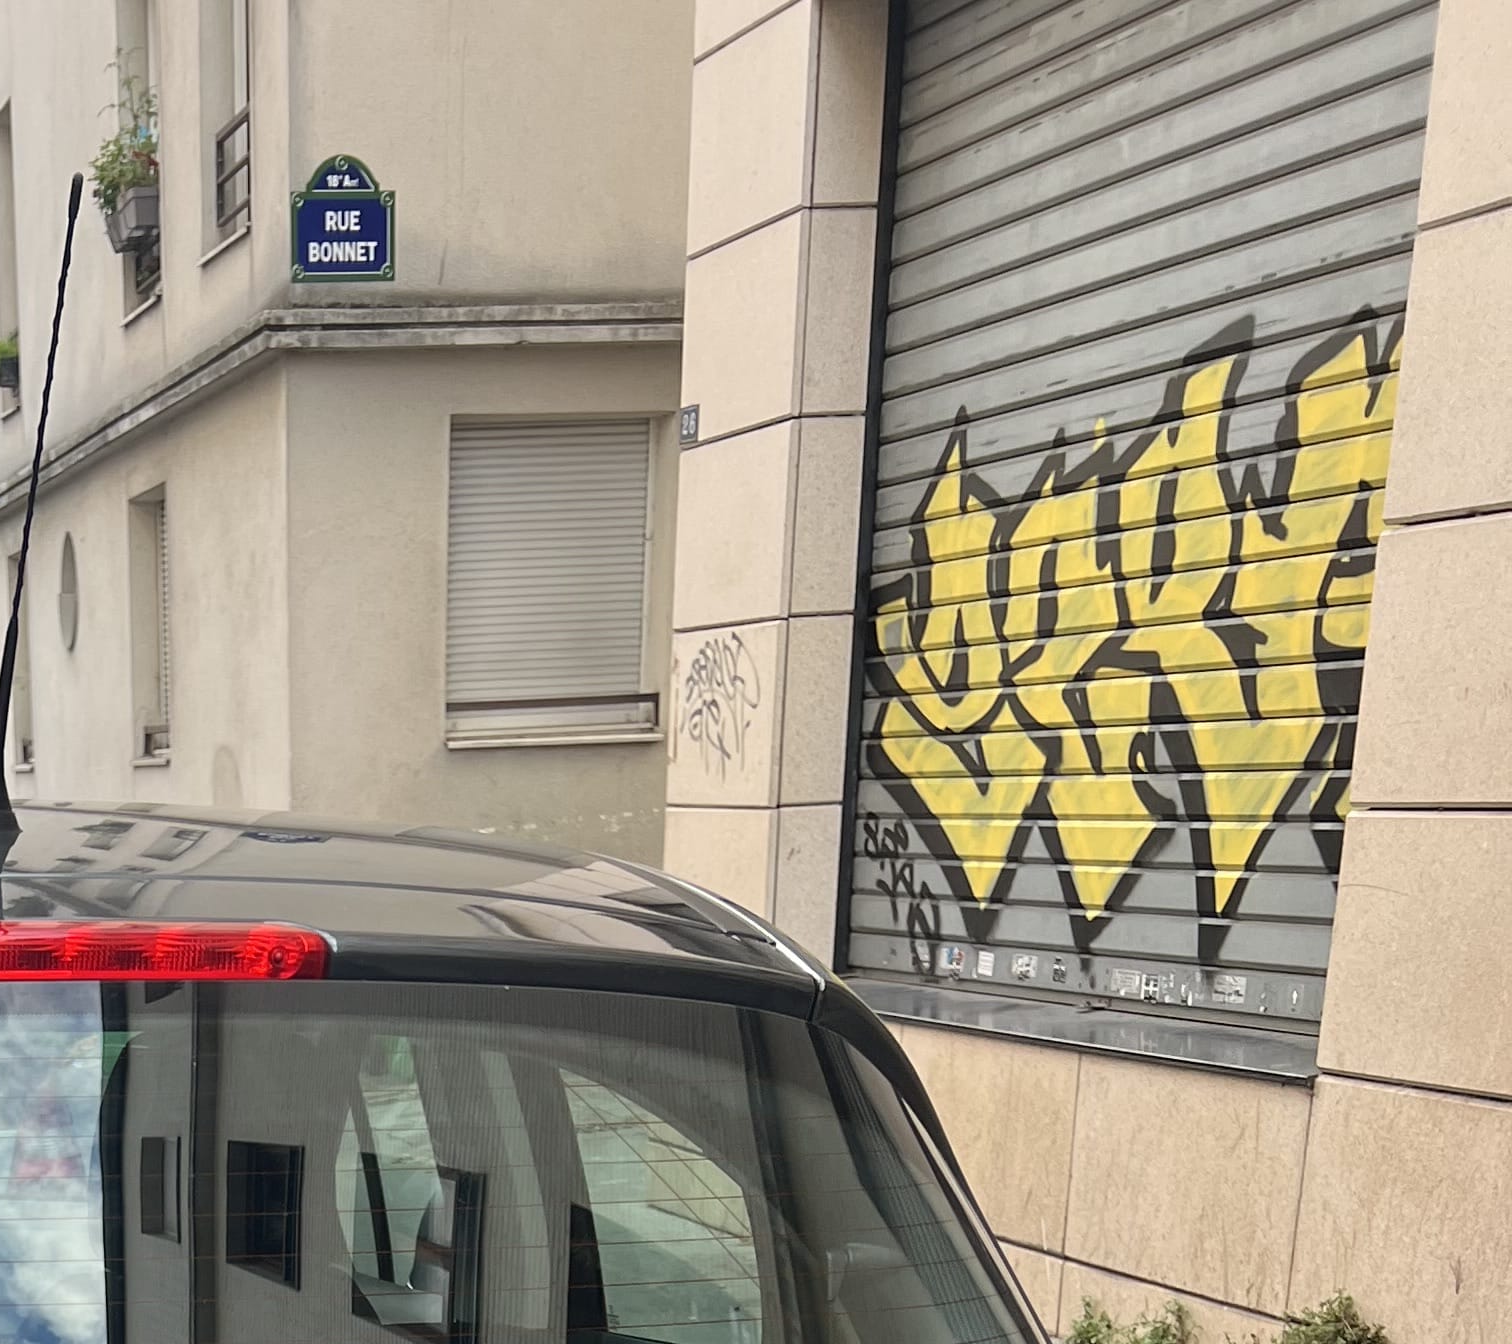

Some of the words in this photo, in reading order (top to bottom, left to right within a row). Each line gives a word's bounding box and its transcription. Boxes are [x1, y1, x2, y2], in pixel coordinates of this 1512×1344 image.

[324, 210, 361, 231] RUE
[307, 241, 378, 263] BONNET
[682, 412, 697, 436] 26
